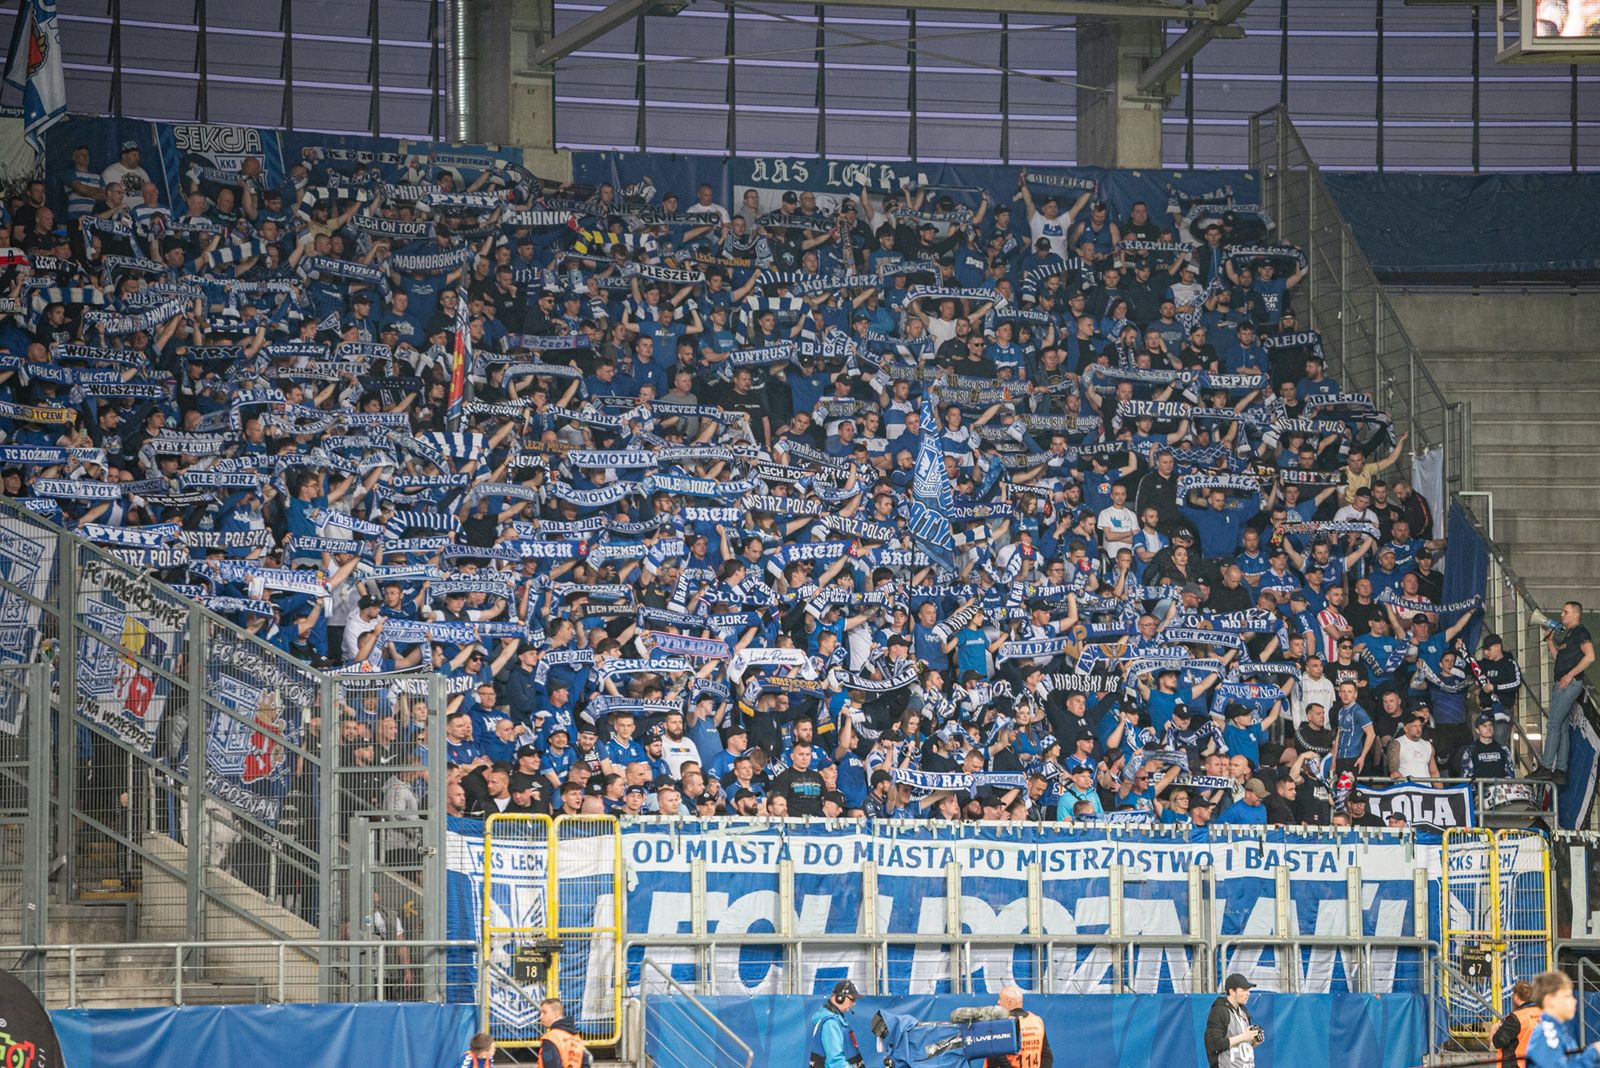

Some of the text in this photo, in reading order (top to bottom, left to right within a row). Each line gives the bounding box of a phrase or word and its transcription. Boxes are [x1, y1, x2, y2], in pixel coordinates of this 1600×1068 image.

[173, 126, 262, 152] SEKCJA
[353, 215, 426, 235] LECH ON TOUR
[639, 265, 700, 282] PLESZEW
[35, 410, 64, 421] TCZEW
[6, 449, 19, 460] FC
[570, 452, 655, 465] SZAMOTUŁY
[393, 473, 469, 488] OPALENICA
[88, 528, 161, 545] PYRY
[294, 537, 319, 549] LECH
[1169, 630, 1195, 641] LECH
[633, 840, 674, 865] OD
[686, 840, 793, 865] MIASTA
[804, 843, 844, 867] DO
[853, 844, 956, 869] MIASTA
[968, 848, 1005, 870] PO
[1016, 847, 1216, 873] MISTRZOSTWO
[1225, 847, 1234, 871] I
[1246, 847, 1338, 873] BASTA
[525, 966, 538, 978] 18
